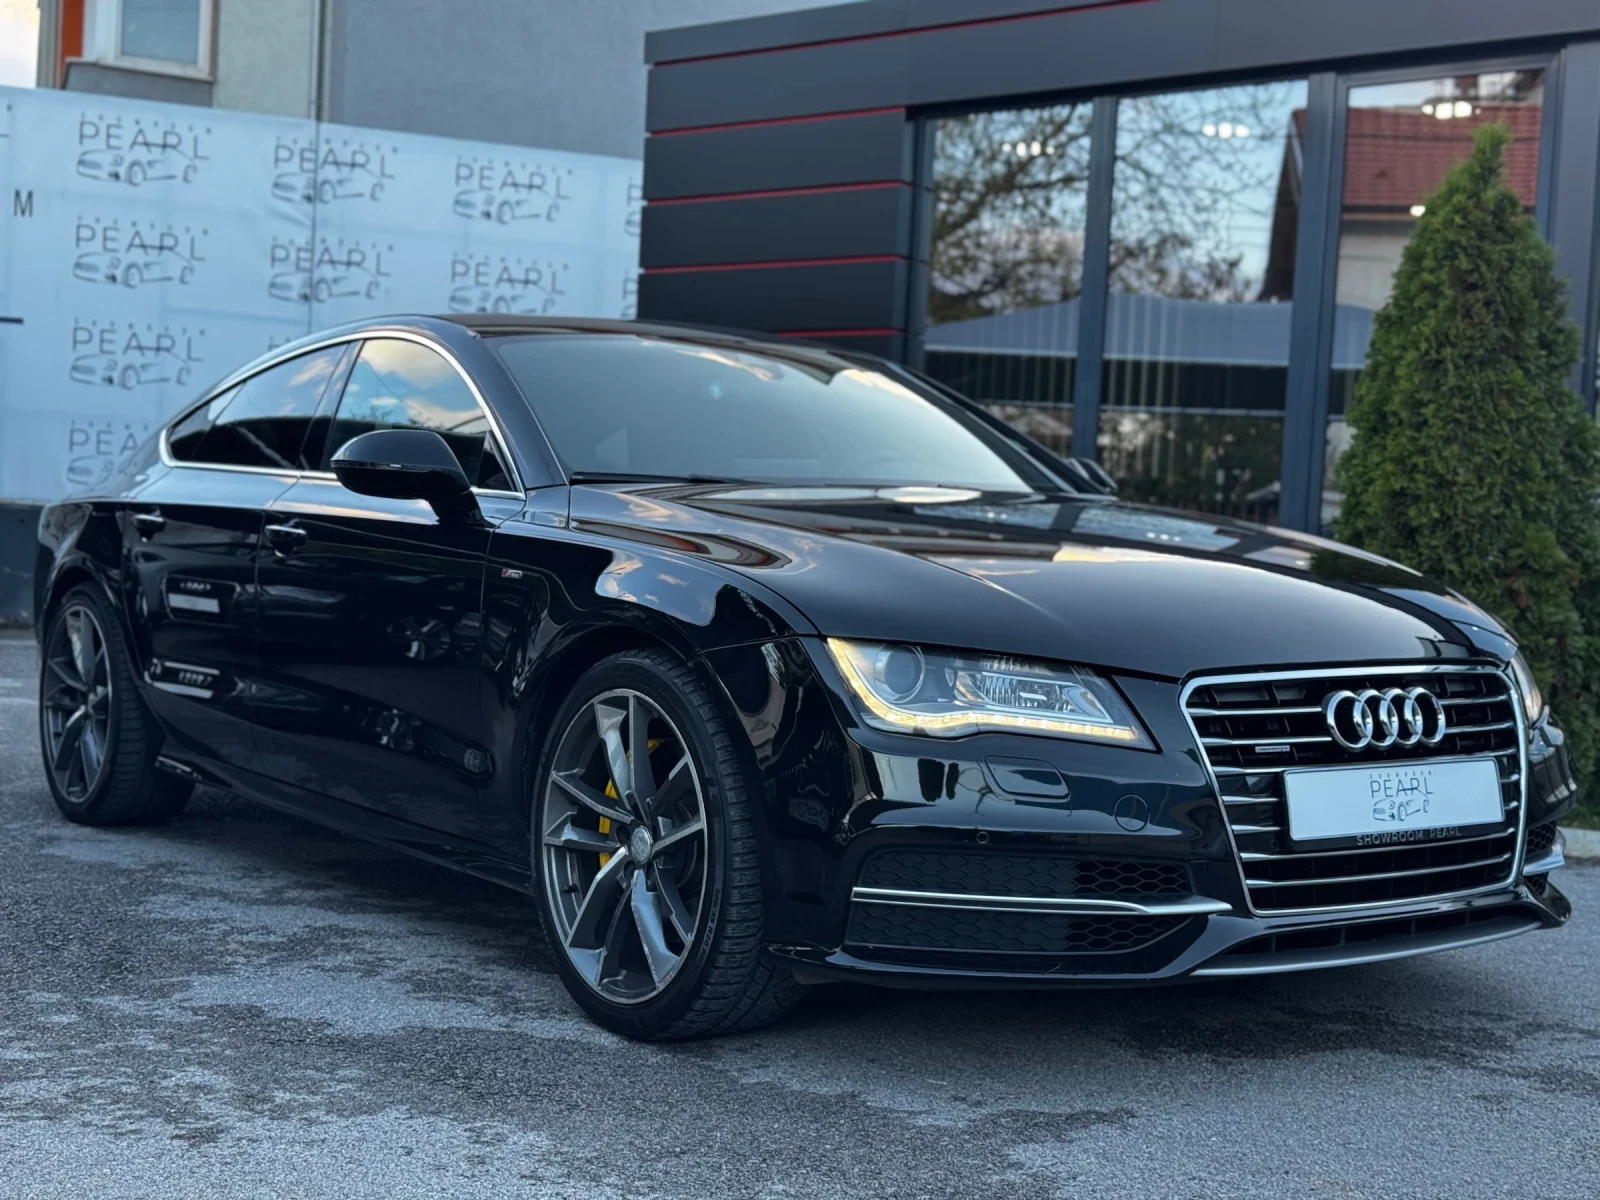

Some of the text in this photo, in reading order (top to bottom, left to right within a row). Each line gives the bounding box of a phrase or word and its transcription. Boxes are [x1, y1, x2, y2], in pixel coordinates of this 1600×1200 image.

[79, 120, 210, 160] PEARL
[274, 144, 395, 179] PEARL
[455, 162, 571, 200] PEARL
[75, 223, 206, 261] PEARL
[270, 244, 390, 277] PEARL
[451, 259, 566, 295] PEARL
[72, 326, 203, 362] PEARL
[1370, 777, 1433, 798] PEARL
[1356, 827, 1462, 846] SHOWROOM PEARL
